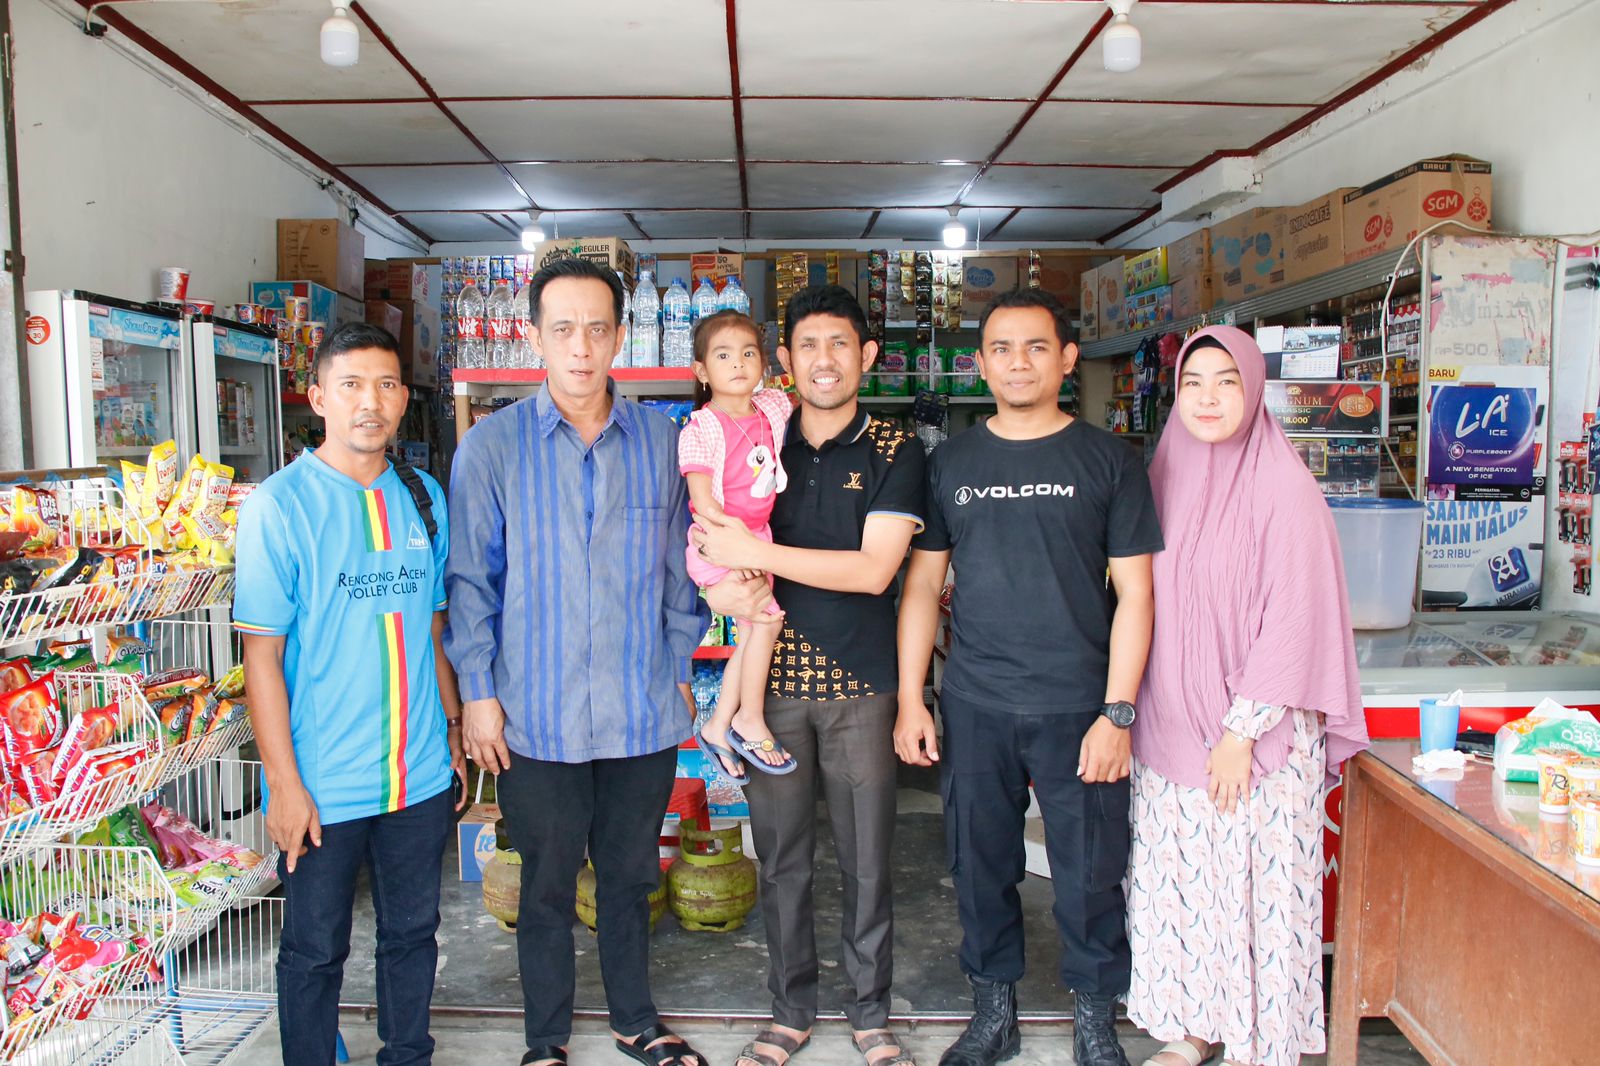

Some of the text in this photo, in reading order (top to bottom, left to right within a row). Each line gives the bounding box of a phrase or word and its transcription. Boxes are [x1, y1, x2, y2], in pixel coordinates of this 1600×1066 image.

[1427, 194, 1459, 212] SGM
[1365, 219, 1381, 239] SGM
[578, 244, 610, 253] REGULER
[515, 318, 532, 337] Vi
[1428, 368, 1456, 379] BARU
[1489, 429, 1508, 437] ICE
[1445, 465, 1517, 474] A NEW SENSATION
[973, 484, 1074, 498] VOLCOM
[1426, 501, 1502, 521] SAATNYA
[1426, 505, 1529, 546] MAIN HALUS
[1432, 549, 1445, 559] 23
[1447, 549, 1472, 559] RIBU
[338, 564, 426, 588] RENCONG ACEH
[347, 582, 418, 600] VOLLEY CLUB
